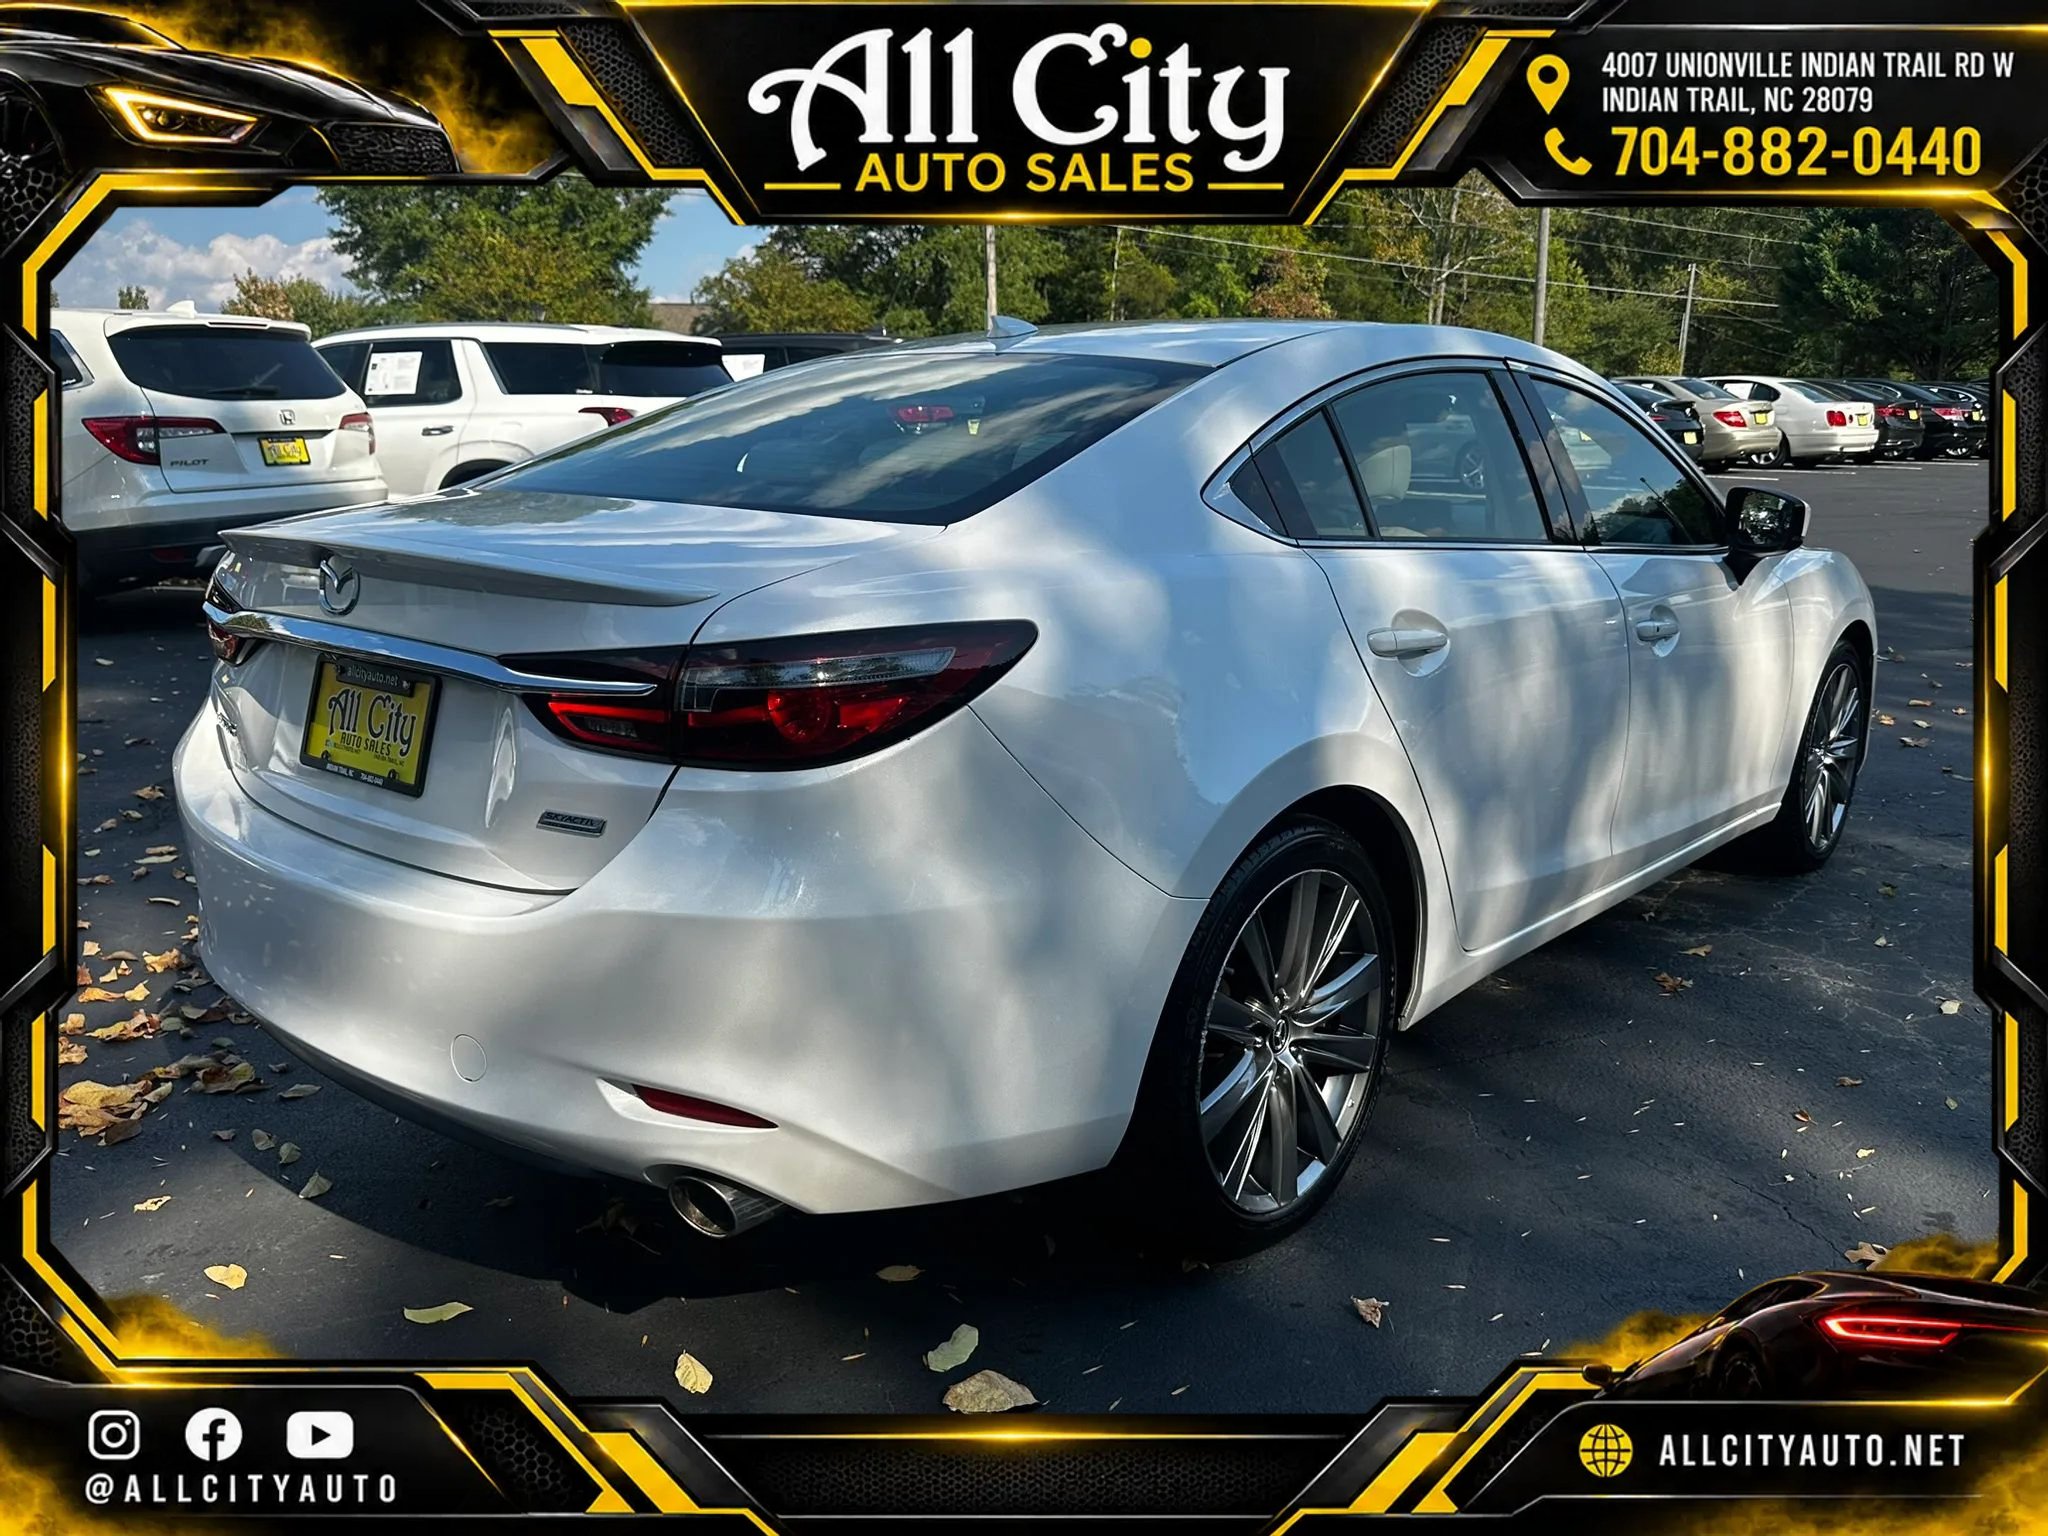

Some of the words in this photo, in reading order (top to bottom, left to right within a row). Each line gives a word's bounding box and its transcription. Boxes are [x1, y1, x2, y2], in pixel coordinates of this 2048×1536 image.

[170, 459, 209, 467] PILOT
[328, 688, 363, 736] All
[367, 693, 418, 758] City
[340, 732, 363, 749] AUTO
[363, 738, 392, 756] SALES
